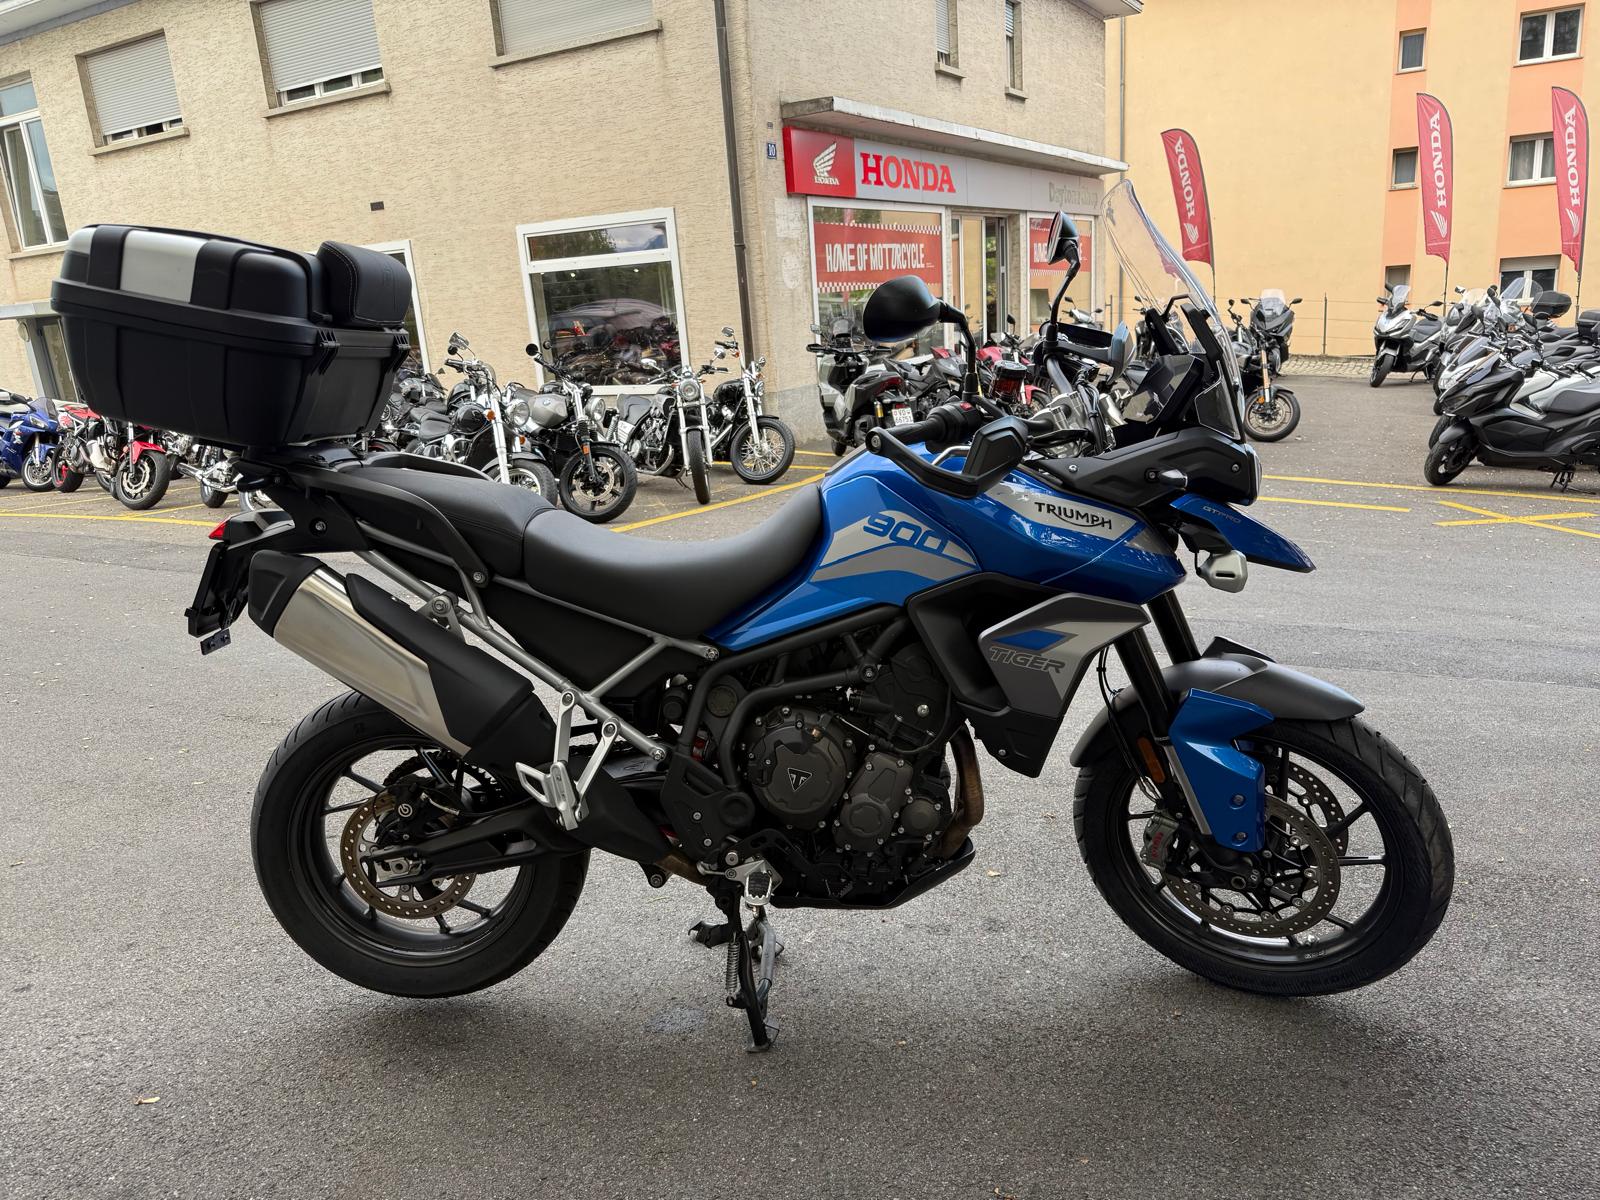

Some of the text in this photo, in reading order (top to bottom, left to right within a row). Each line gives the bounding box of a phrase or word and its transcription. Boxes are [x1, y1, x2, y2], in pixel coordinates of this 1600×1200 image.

[860, 152, 956, 193] HONDA
[1430, 110, 1447, 208] HONDA
[1563, 105, 1580, 206] HONDA
[814, 175, 840, 186] HONDA
[1175, 135, 1195, 219] HONDA
[857, 243, 868, 271] OF
[863, 514, 947, 555] 900
[1034, 502, 1112, 530] TRIUMPH
[989, 646, 1066, 674] TIGER
